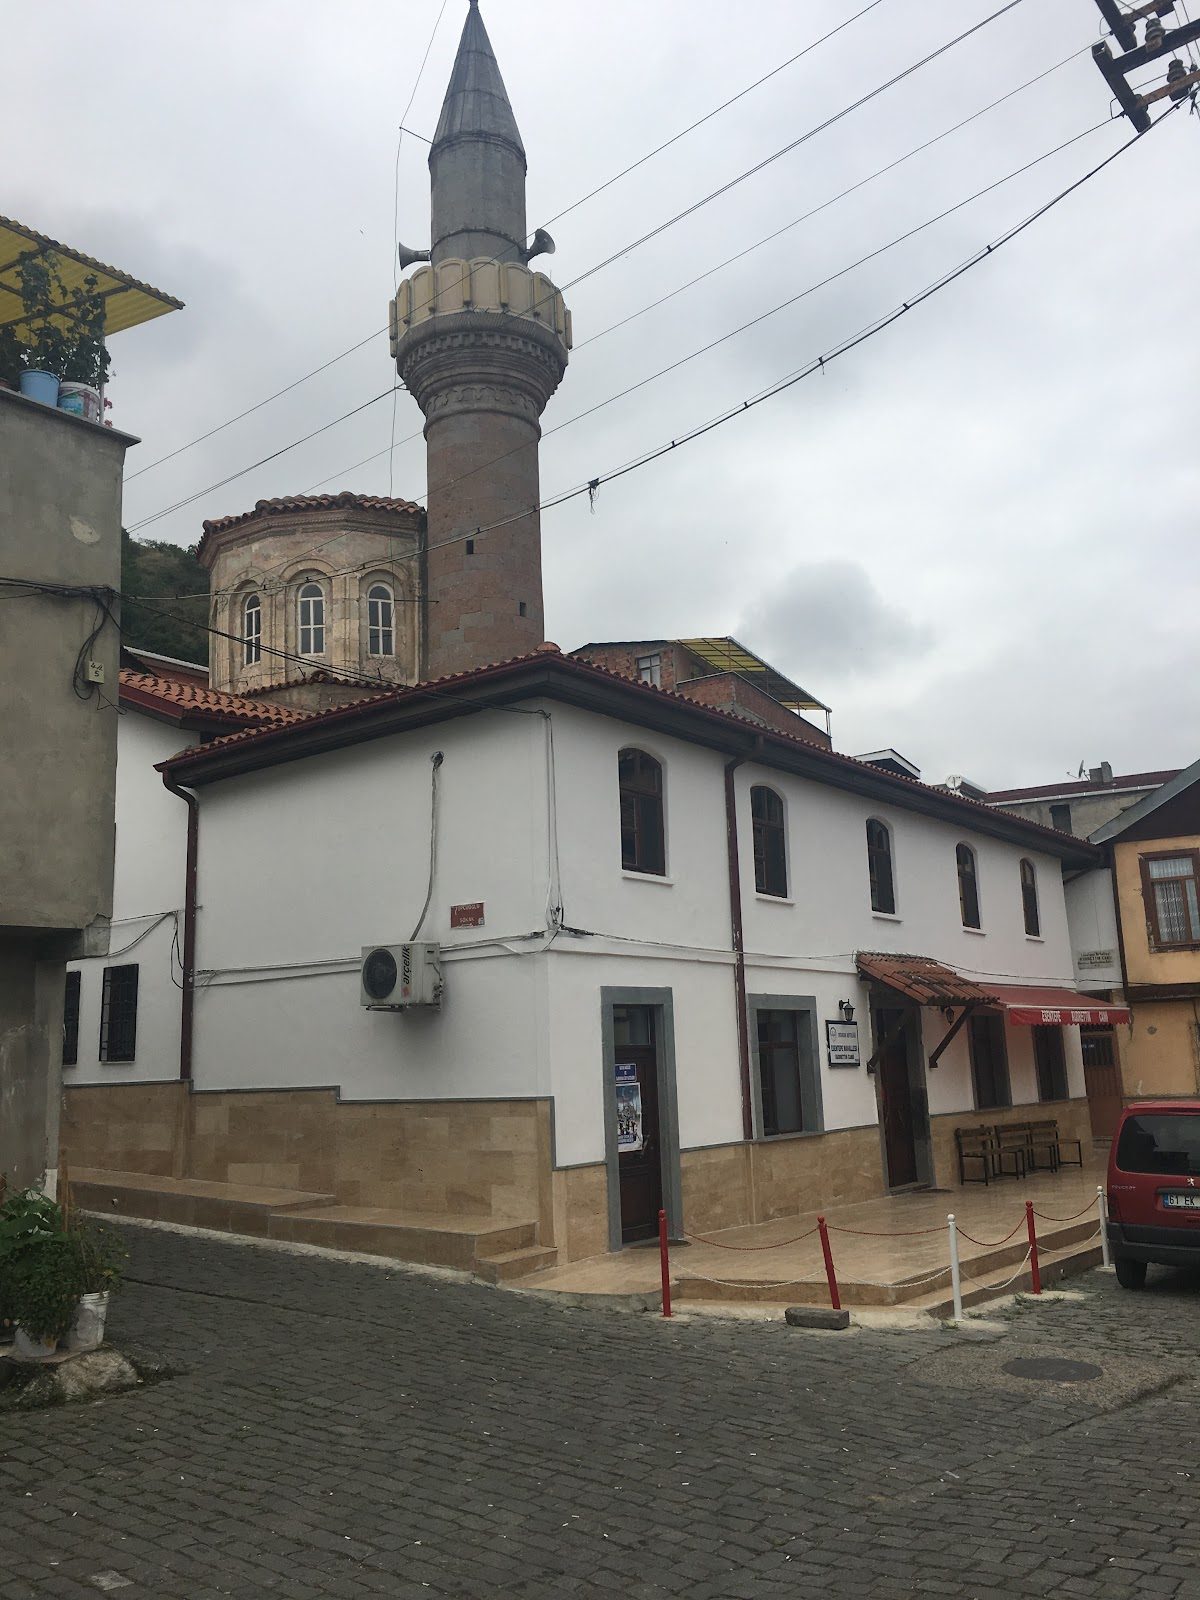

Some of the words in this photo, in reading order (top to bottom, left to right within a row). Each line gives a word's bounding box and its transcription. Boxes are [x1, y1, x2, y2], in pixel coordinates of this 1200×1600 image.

[402, 944, 412, 984] arçelik
[1169, 1195, 1179, 1204] 61
[1184, 1196, 1195, 1206] EK
